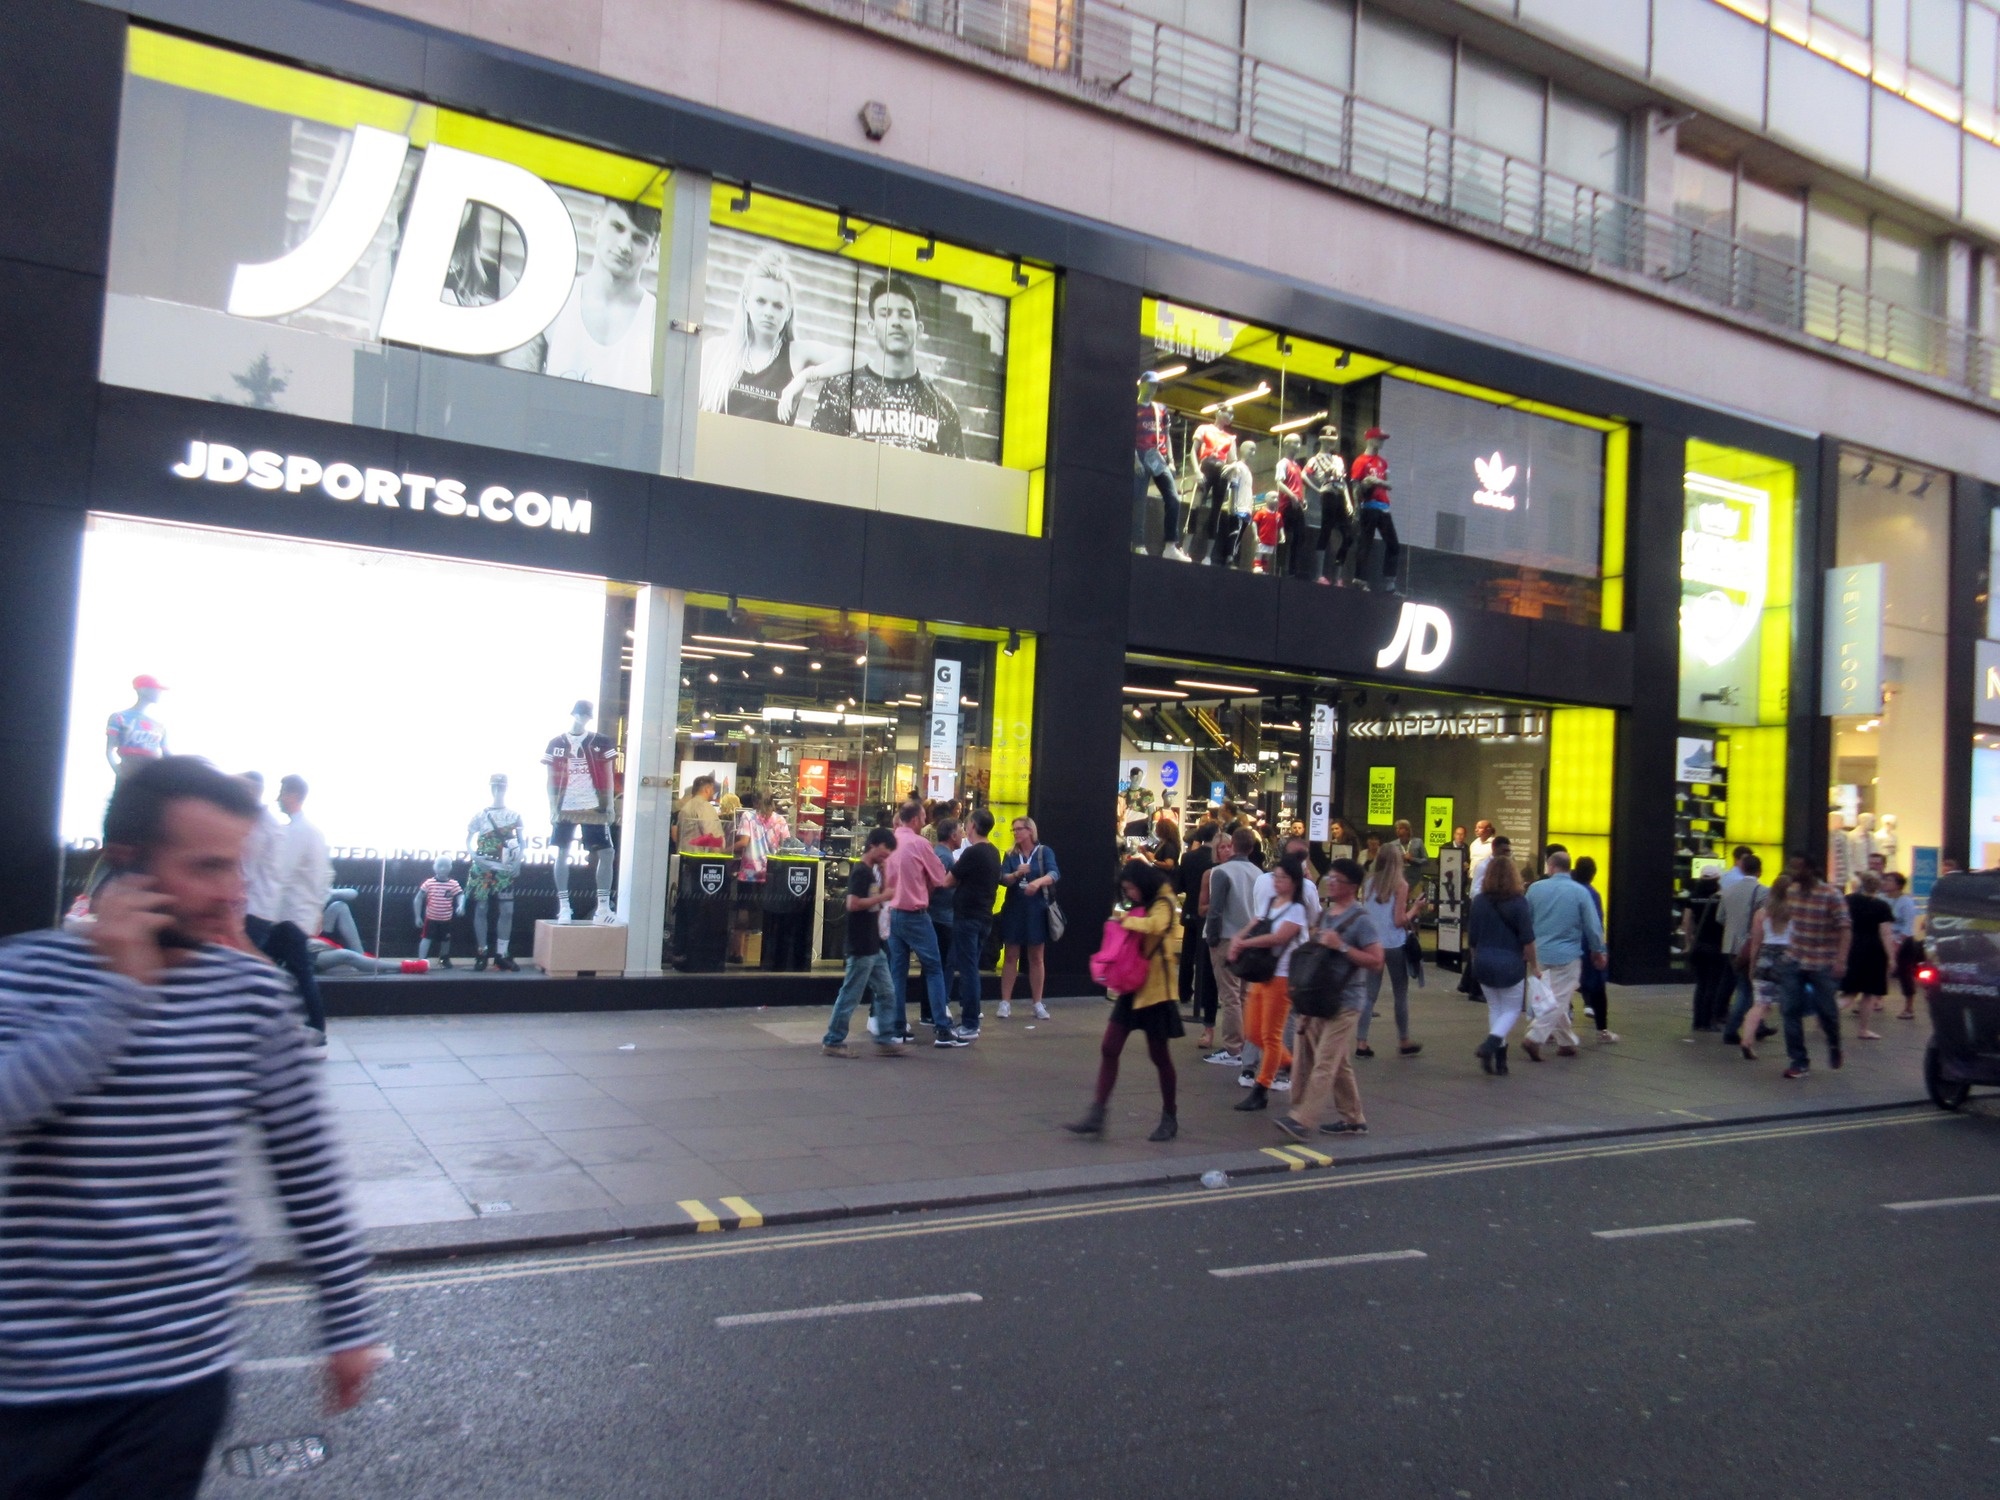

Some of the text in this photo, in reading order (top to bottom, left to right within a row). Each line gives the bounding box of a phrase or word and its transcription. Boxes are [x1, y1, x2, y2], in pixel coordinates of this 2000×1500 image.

[227, 123, 579, 355] JD
[852, 408, 939, 443] WARRIOR
[173, 441, 594, 534] JDSPORTS.COM
[1376, 602, 1452, 672] JD
[937, 666, 951, 683] G
[1317, 709, 1326, 723] 2
[933, 719, 946, 737] 2
[1383, 711, 1511, 741] APPAREL
[553, 747, 565, 757] 03
[568, 766, 591, 775] adida
[1234, 763, 1257, 773] MENS
[1315, 755, 1321, 770] 1
[931, 775, 940, 792] 1
[1312, 801, 1322, 816] G
[704, 873, 721, 881] KING
